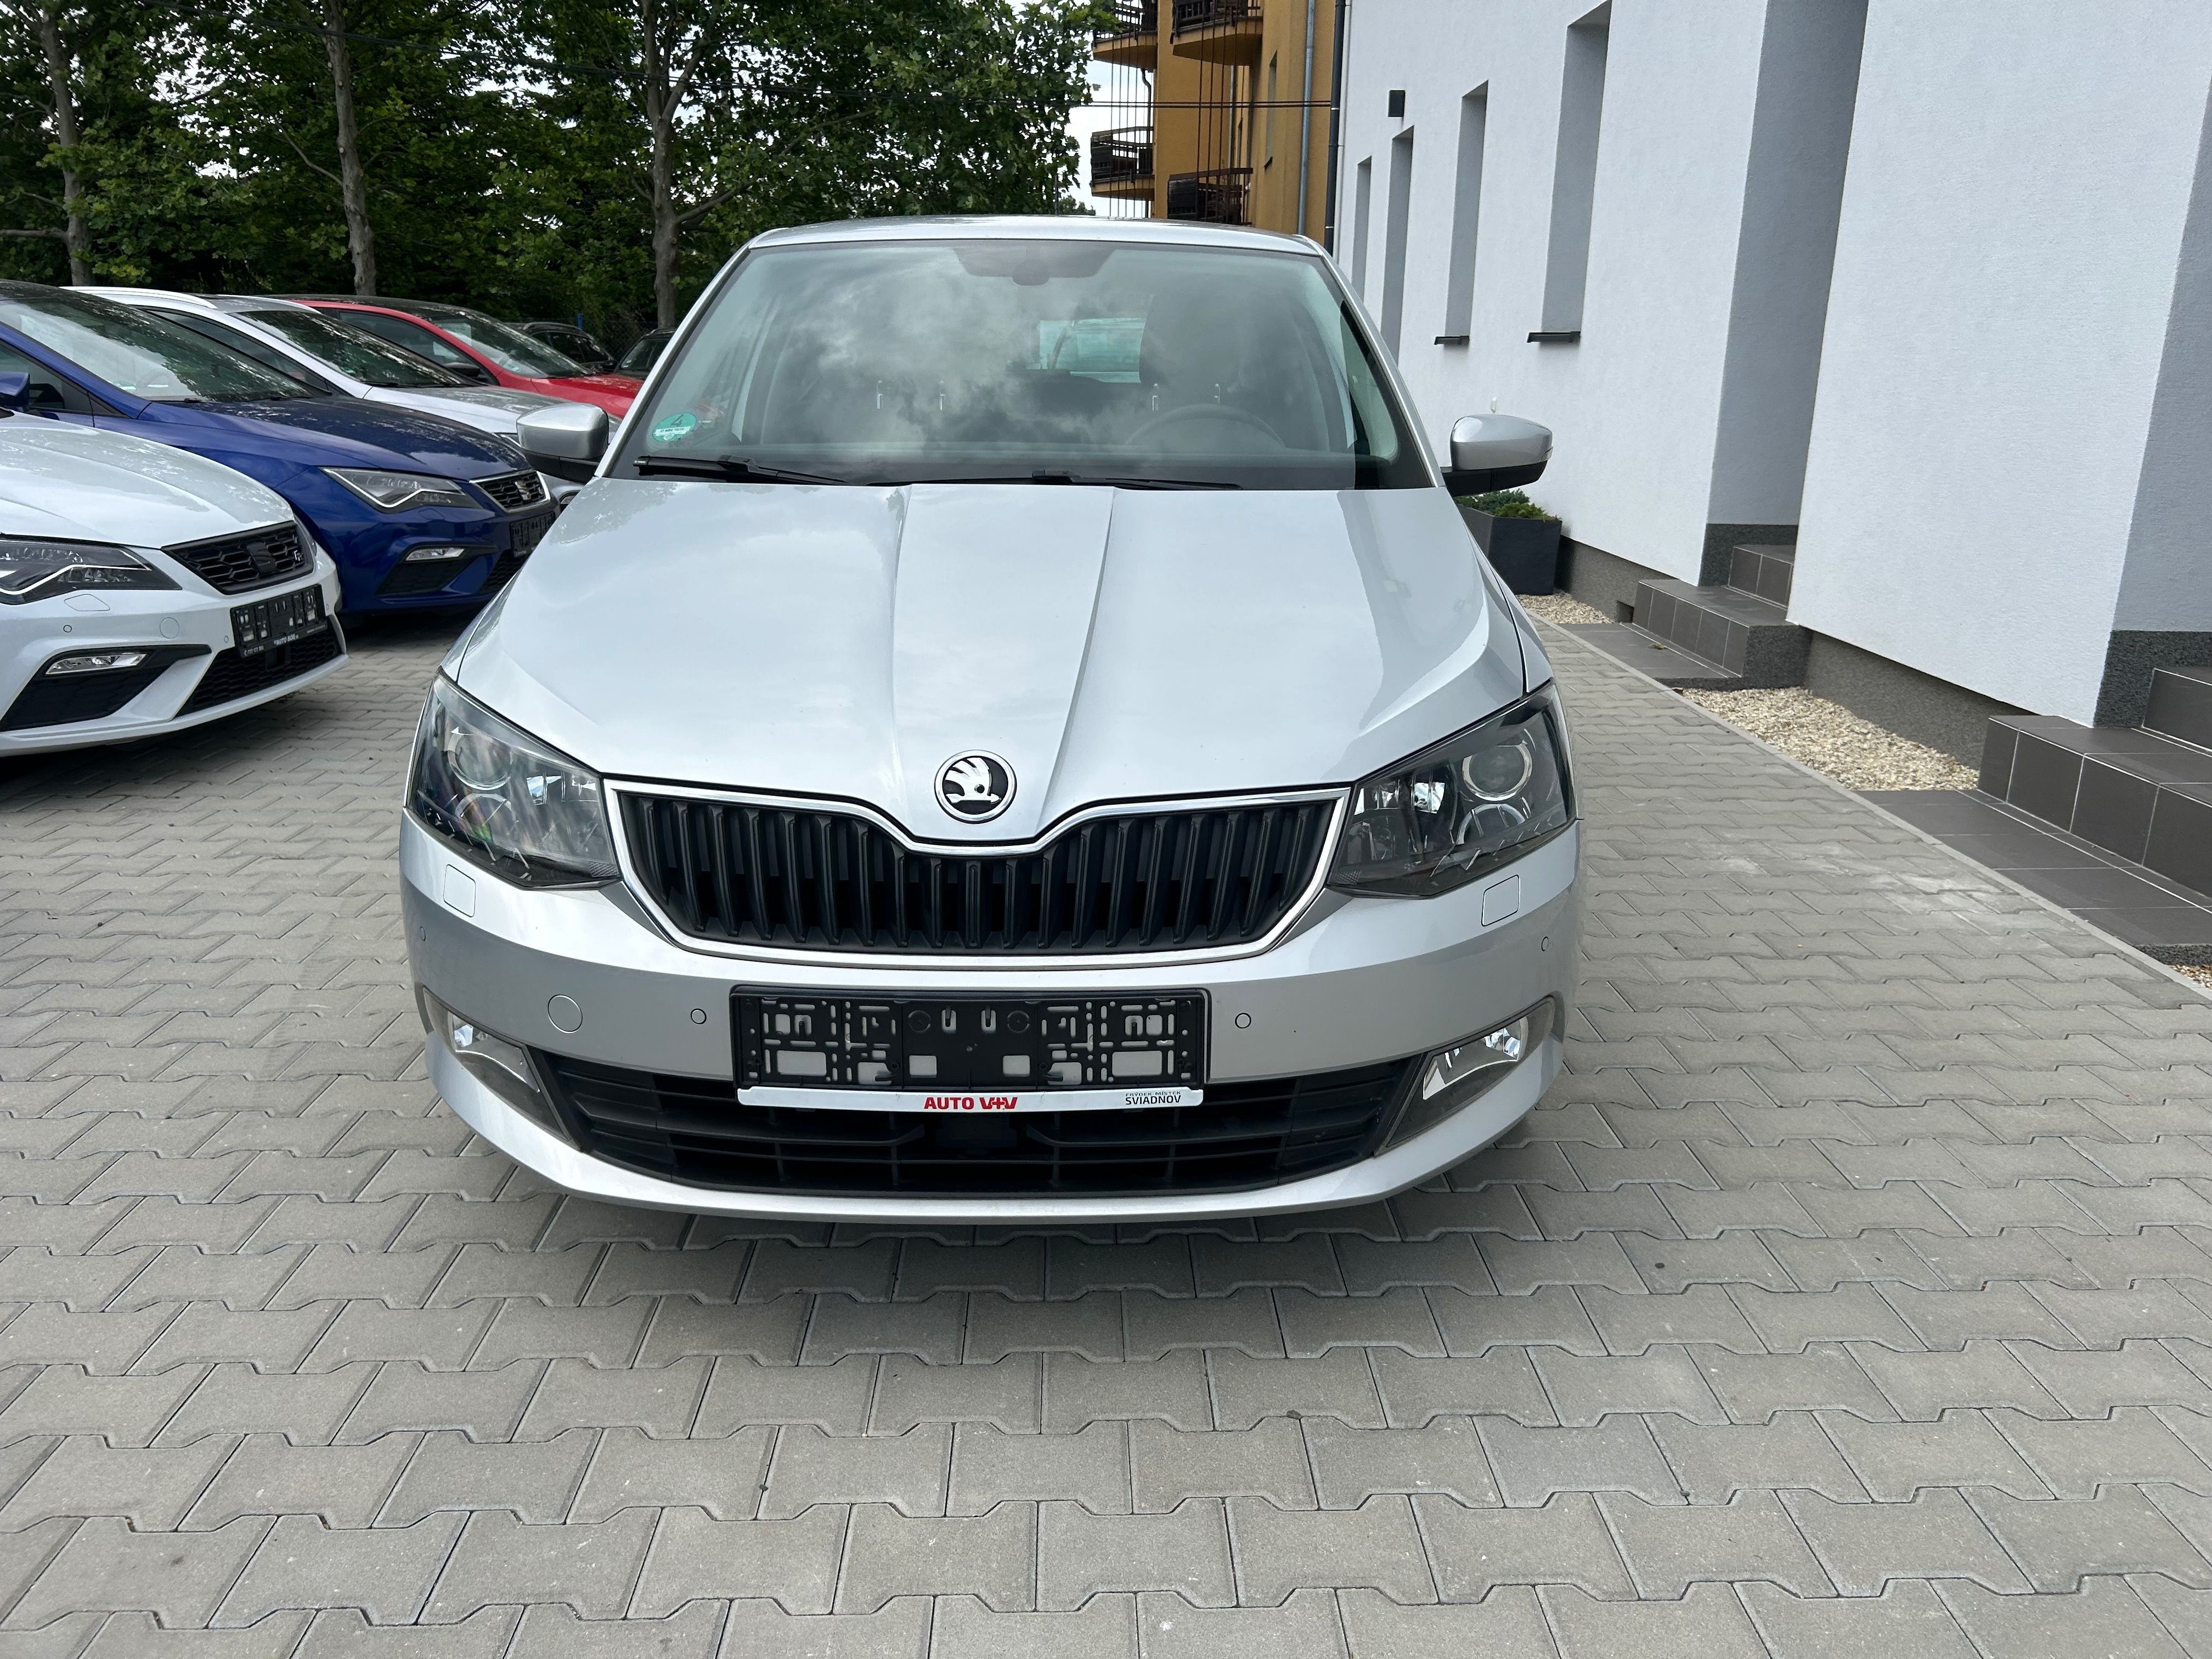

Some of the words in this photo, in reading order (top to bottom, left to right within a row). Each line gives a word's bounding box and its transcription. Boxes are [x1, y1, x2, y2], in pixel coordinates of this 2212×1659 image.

[670, 414, 685, 427] 4
[924, 1097, 974, 1109] AUTO
[1125, 1096, 1181, 1105] SVIADNOV
